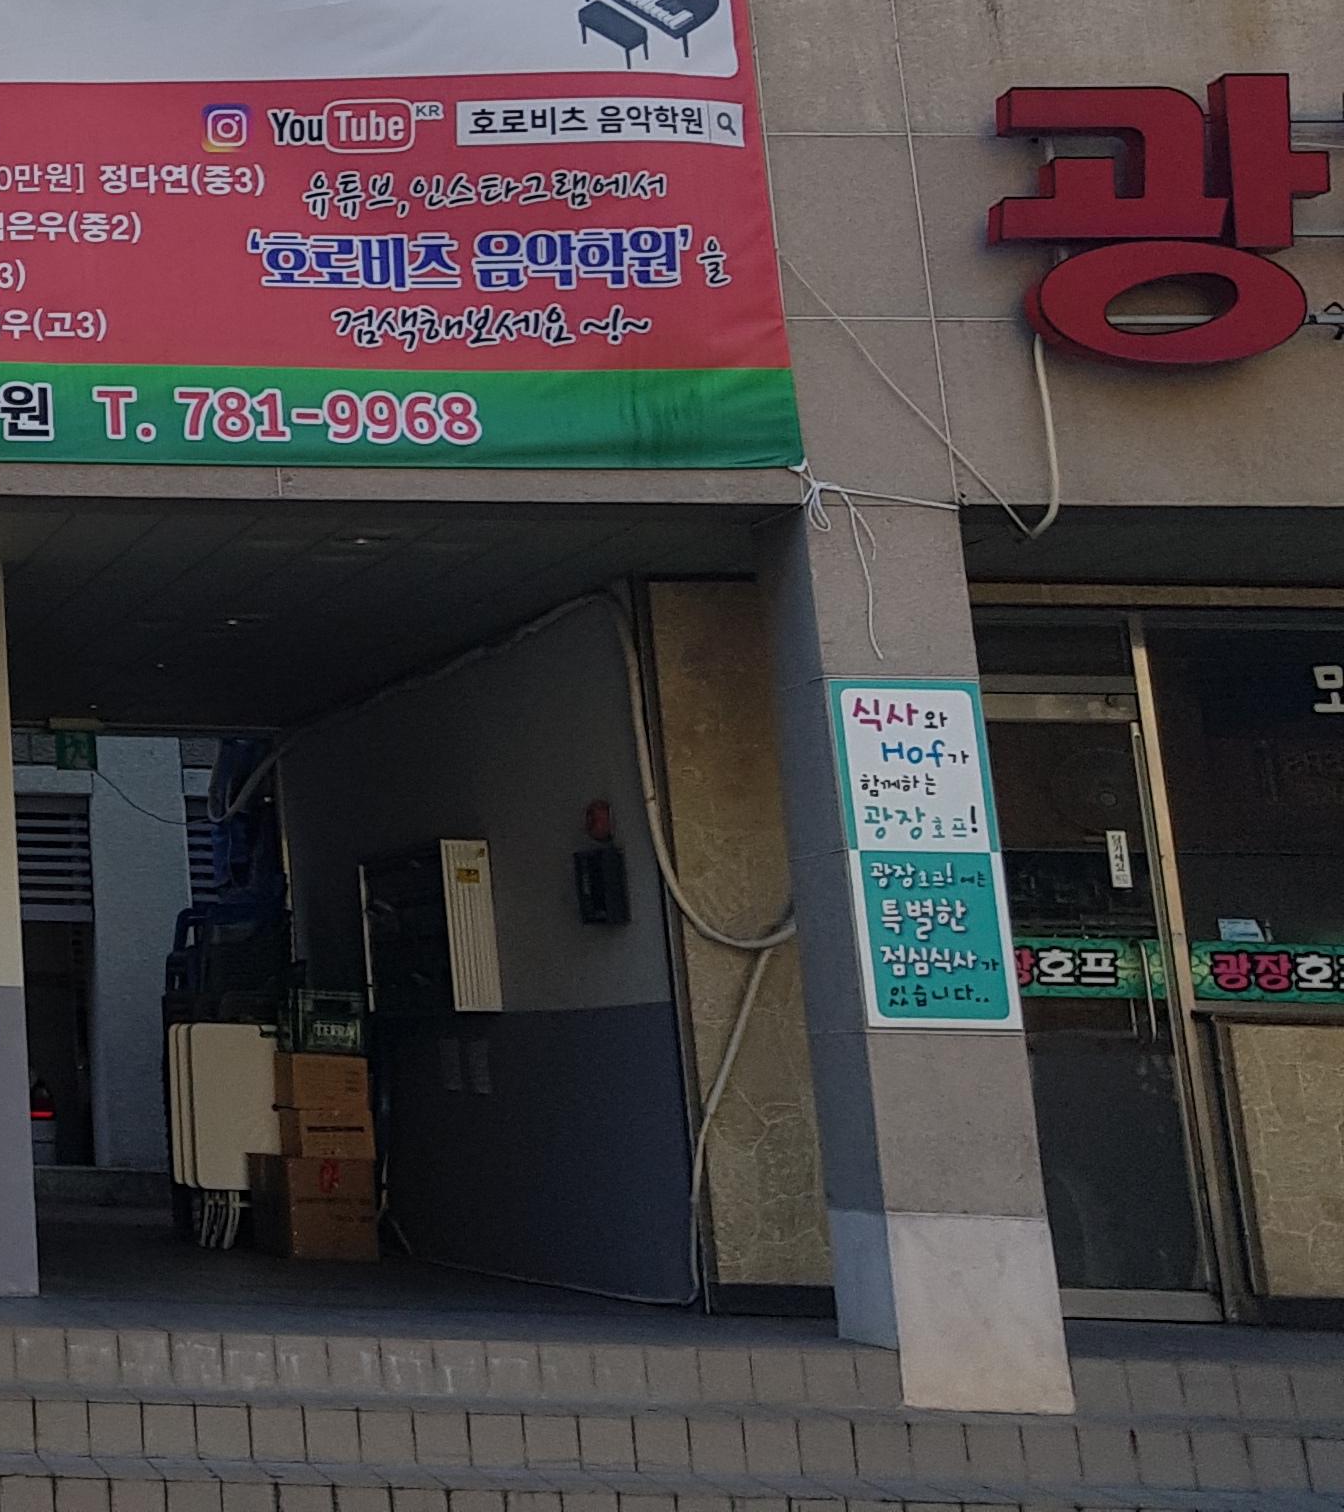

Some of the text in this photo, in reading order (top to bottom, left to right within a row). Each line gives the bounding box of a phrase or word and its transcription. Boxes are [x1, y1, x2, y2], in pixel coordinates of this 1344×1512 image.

[469, 105, 704, 135] 호로비츠 음악학원
[97, 162, 267, 198] 정다연(중3)
[331, 306, 573, 350] 검색해보세요
[95, 386, 156, 440] T.
[179, 387, 484, 444] 781-9968
[852, 697, 948, 732] 식사와
[860, 775, 937, 797] 함께하는
[880, 899, 967, 941] 특별한
[880, 945, 1000, 977] 점심식사가
[1213, 950, 1344, 992] 광장호
